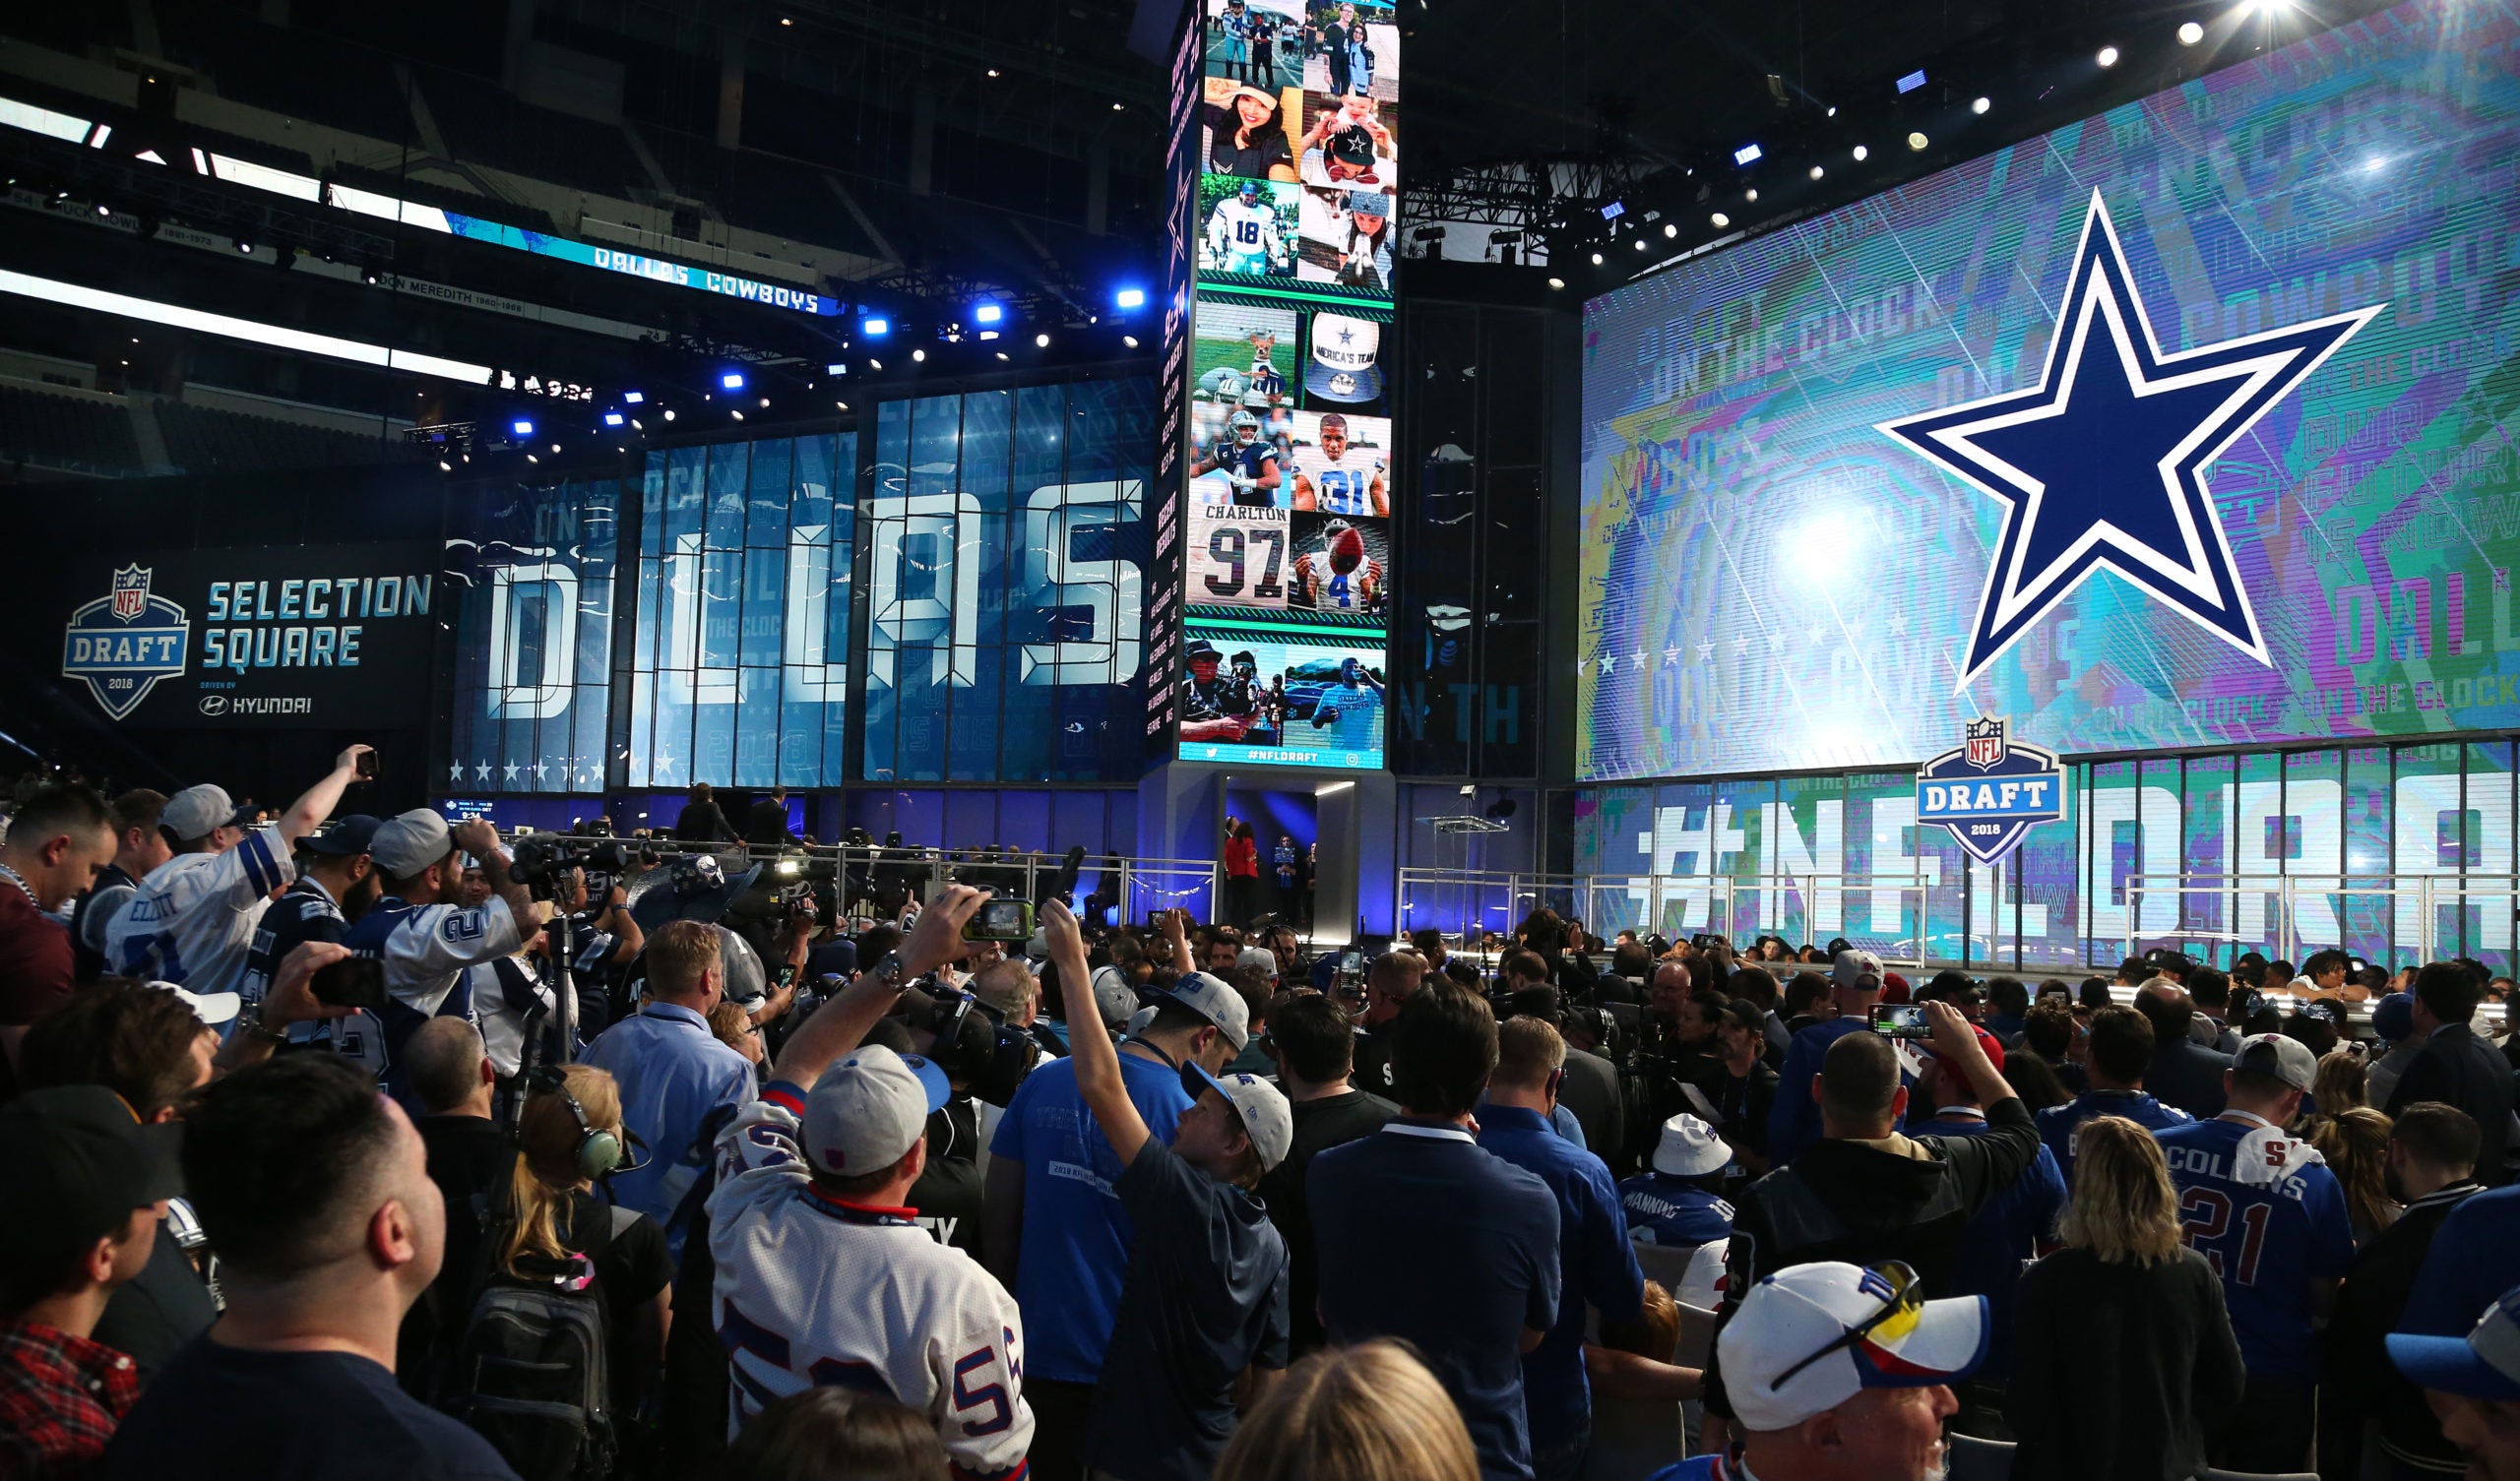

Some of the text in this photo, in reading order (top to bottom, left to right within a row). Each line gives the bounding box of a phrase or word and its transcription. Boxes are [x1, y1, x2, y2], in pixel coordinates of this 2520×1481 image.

[1235, 219, 1259, 244] 18
[410, 280, 472, 303] MEREDITH
[594, 247, 818, 314] DALLAS COWBOYS
[1709, 322, 1785, 388] THE
[1797, 275, 1943, 362] CLOCK
[1230, 463, 1254, 495] 4
[1320, 469, 1364, 517] 31
[1206, 505, 1287, 522] CHARLTON
[1204, 527, 1285, 598] 97
[115, 588, 143, 614] NFL
[206, 574, 433, 622] SELECTION
[488, 479, 1142, 719] DLLAS
[1329, 574, 1352, 608] 4
[708, 614, 781, 639] THE CLOC
[72, 635, 178, 664] DRAFT
[202, 625, 363, 676] SQUARE
[107, 678, 133, 690] 2018
[2356, 683, 2408, 714] THE
[232, 697, 312, 715] HYUNDAI
[1247, 749, 1319, 764] #NFLDRAFT
[1968, 738, 2001, 765] NFL
[1924, 780, 2048, 812] DRAFT
[1970, 823, 2002, 836] 2018
[1623, 1190, 1679, 1219] MANNING
[2180, 1184, 2272, 1287] 21
